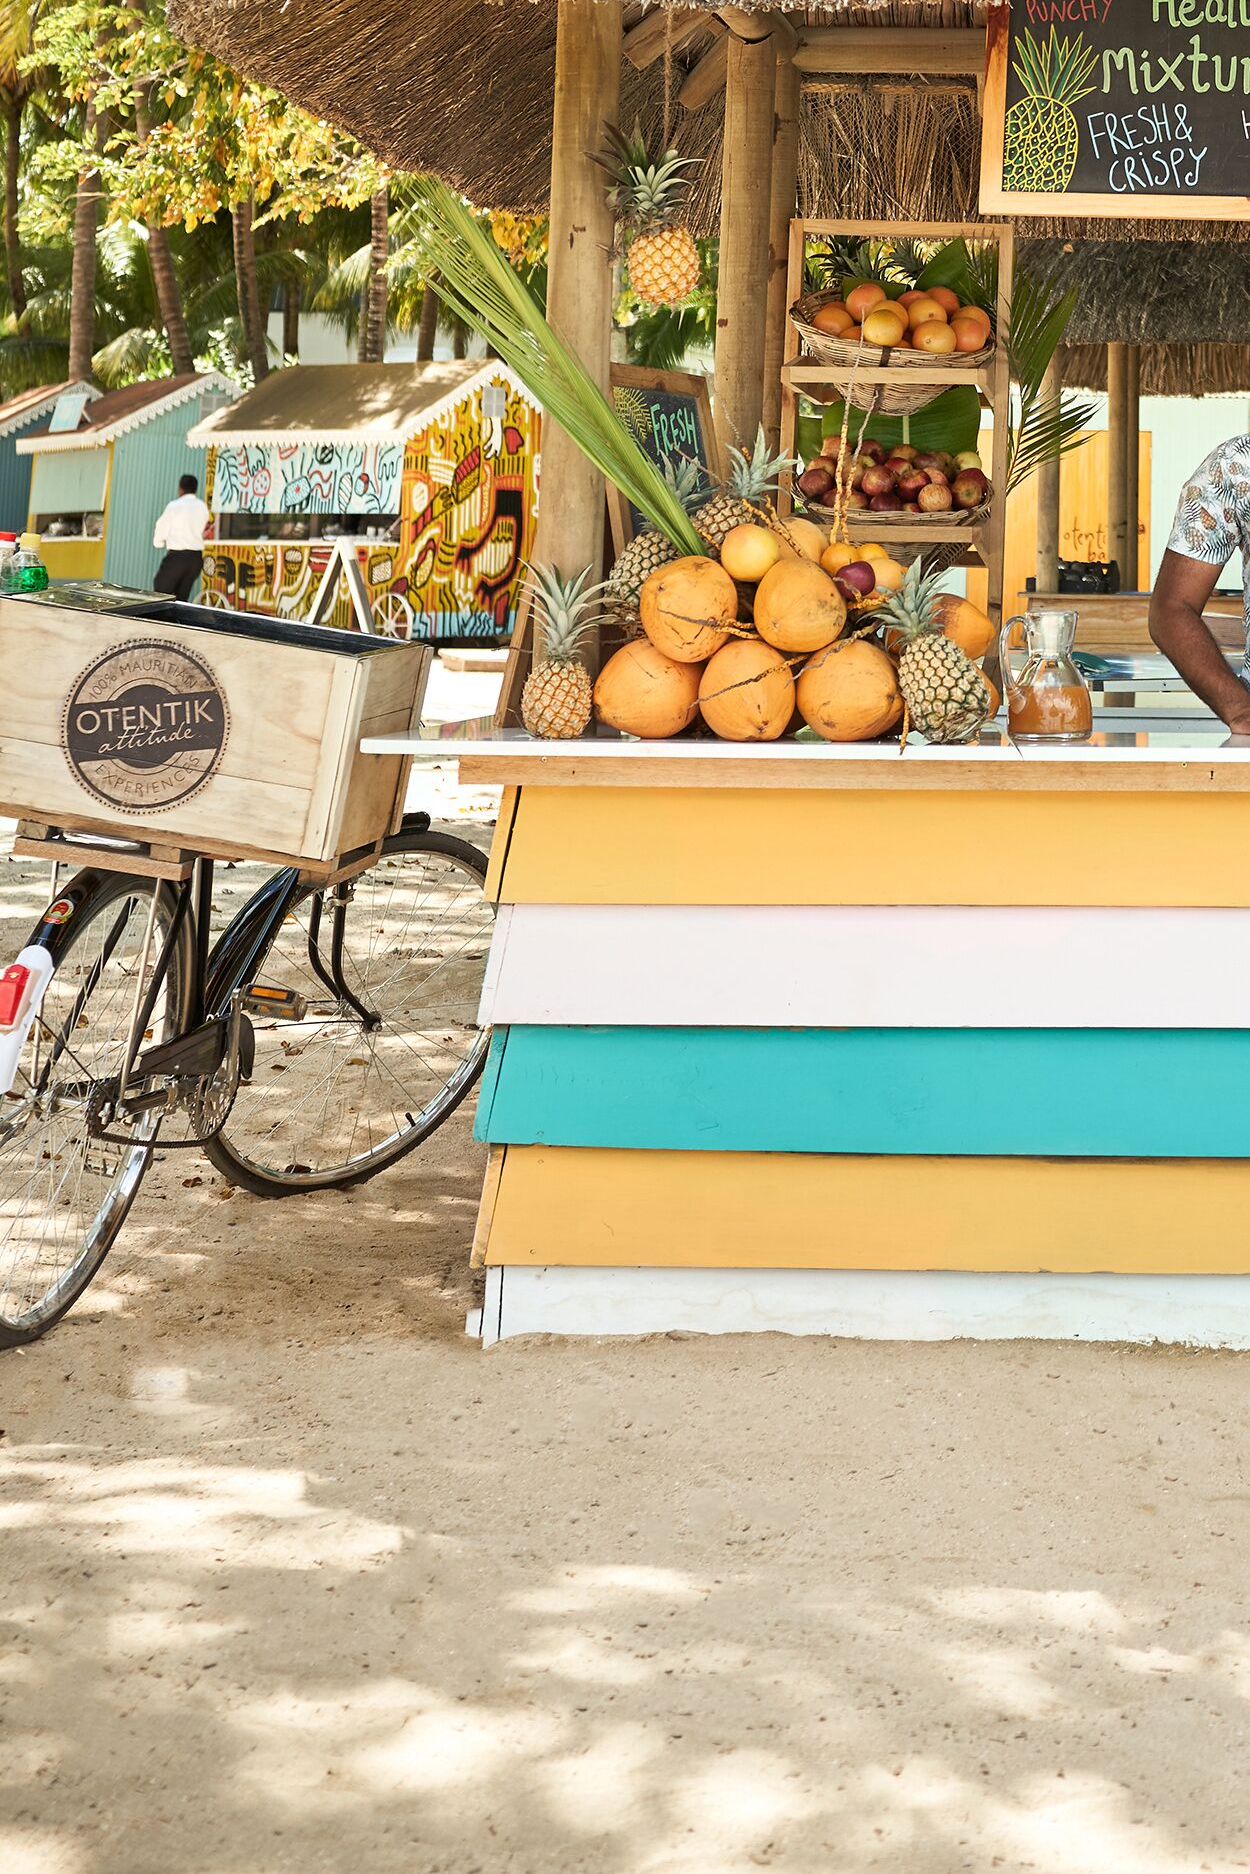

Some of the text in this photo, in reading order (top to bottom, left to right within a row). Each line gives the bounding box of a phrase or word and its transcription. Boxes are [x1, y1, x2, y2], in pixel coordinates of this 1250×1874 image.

[650, 402, 699, 457] FRESH
[89, 658, 199, 700] 100% MAURITIAN
[75, 698, 215, 735] OTENTIK
[97, 721, 196, 754] attitude
[95, 754, 200, 796] EXPERIENCES
